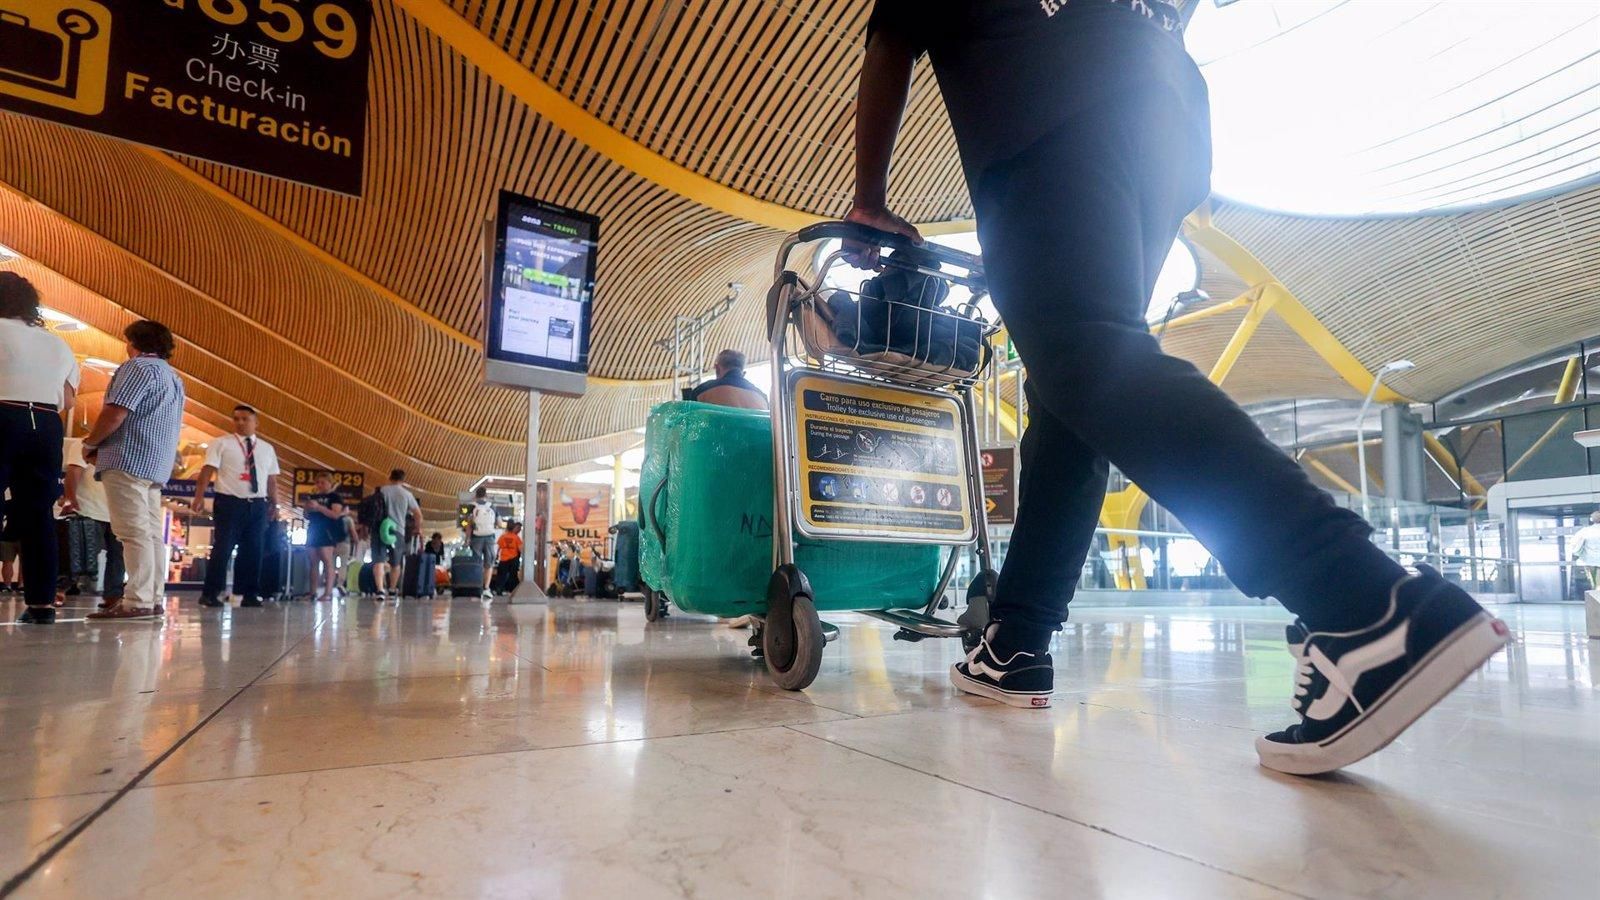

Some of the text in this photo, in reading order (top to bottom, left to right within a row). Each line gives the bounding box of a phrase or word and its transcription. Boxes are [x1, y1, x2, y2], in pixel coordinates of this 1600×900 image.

[212, 33, 280, 74] 办票
[185, 57, 306, 112] Check-in
[124, 71, 352, 158] Facturación
[553, 223, 578, 235] TRAVEL
[820, 393, 839, 403] Carro
[841, 397, 857, 406] para
[872, 402, 901, 412] exclusivo
[911, 408, 940, 418] pasajeros
[827, 403, 847, 413] Trolley
[859, 409, 886, 418] exclusive
[906, 416, 936, 426] passengers
[810, 423, 829, 431] Durante
[810, 430, 825, 438] During
[565, 527, 601, 539] BULL
